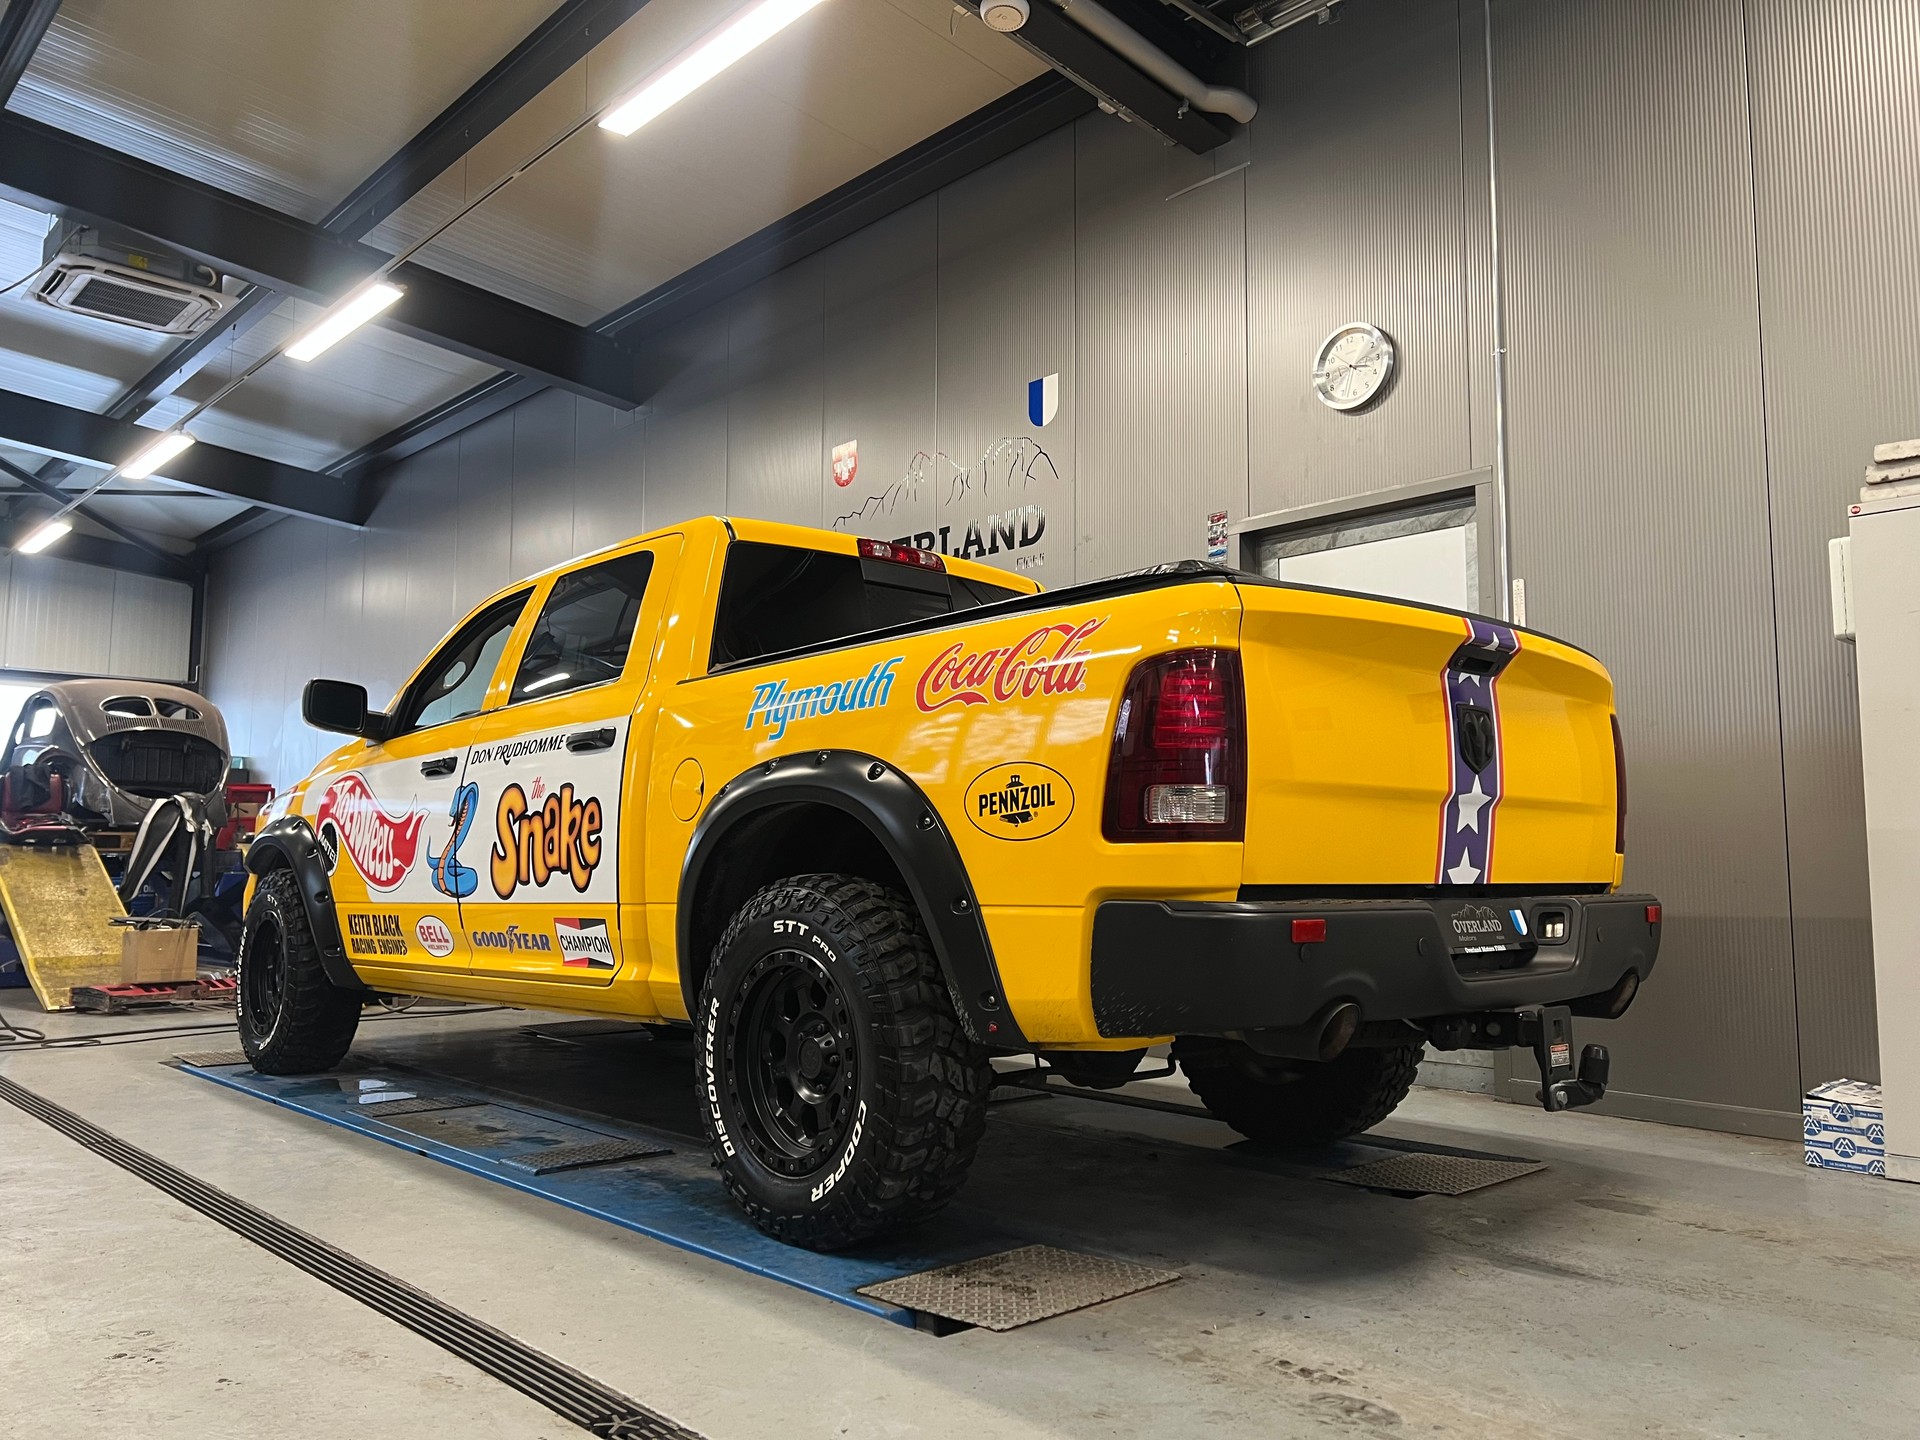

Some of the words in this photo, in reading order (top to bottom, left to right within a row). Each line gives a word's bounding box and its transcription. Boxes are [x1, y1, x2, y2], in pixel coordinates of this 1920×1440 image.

[915, 614, 1111, 714] Coca-Cola
[744, 655, 906, 741] Plymouth
[470, 747, 494, 765] DON
[494, 734, 567, 765] PRUDHOMME
[530, 776, 547, 800] the
[978, 783, 1055, 817] PENNZOIL
[490, 782, 603, 901] Snake
[347, 914, 372, 936] KEITH
[372, 914, 403, 937] BLACK
[418, 925, 450, 943] BELL
[472, 928, 551, 952] GOODYEAR
[1452, 919, 1503, 934] OVERLAND
[351, 938, 377, 954] RACING
[377, 938, 408, 955] ENGINES
[559, 934, 611, 953] CHAMPION
[773, 920, 809, 937] STT
[811, 935, 837, 963] PRO
[704, 997, 736, 1158] DISCOVERER
[810, 1099, 868, 1202] COOPER
